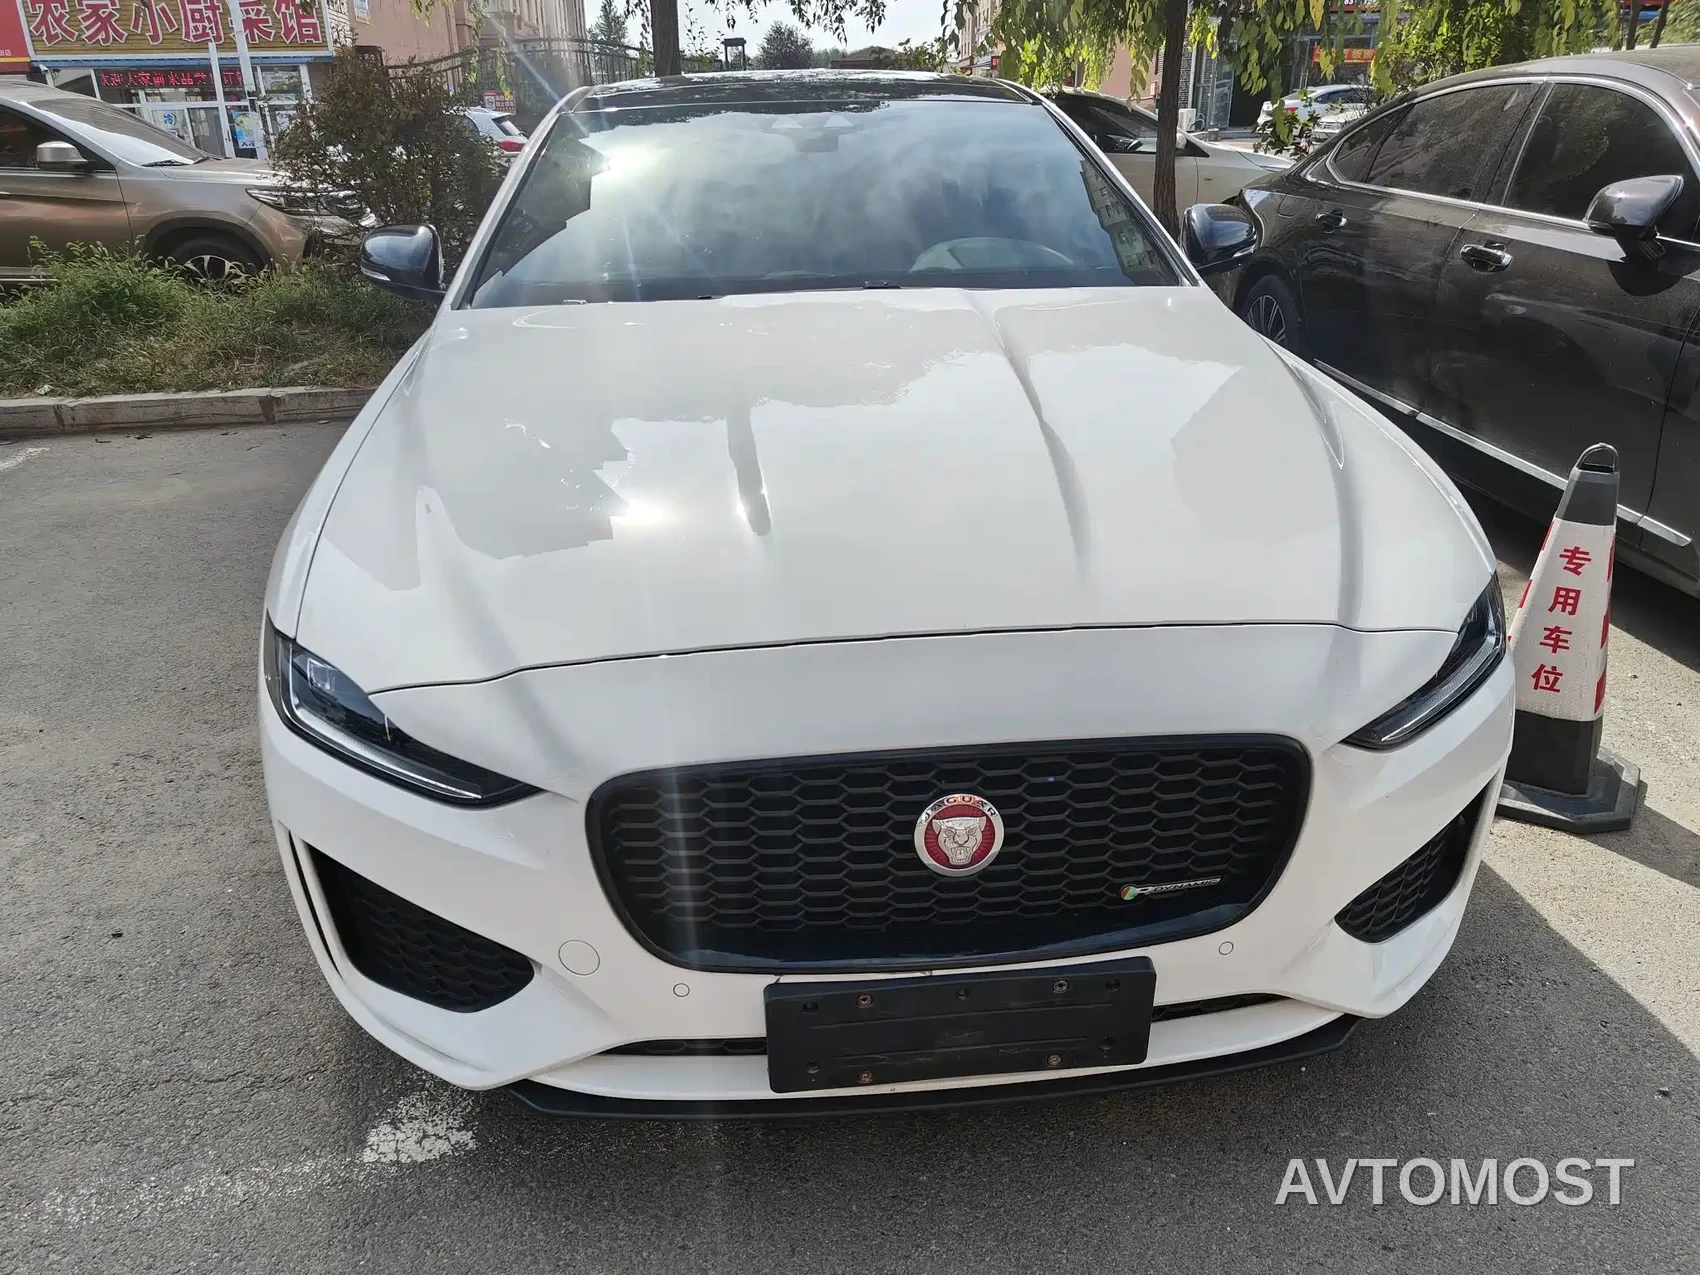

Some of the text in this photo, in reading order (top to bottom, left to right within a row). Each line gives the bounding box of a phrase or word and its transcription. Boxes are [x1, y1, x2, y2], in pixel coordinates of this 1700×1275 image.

[1531, 545, 1592, 693] 专用车位
[920, 795, 998, 825] JAGUAR
